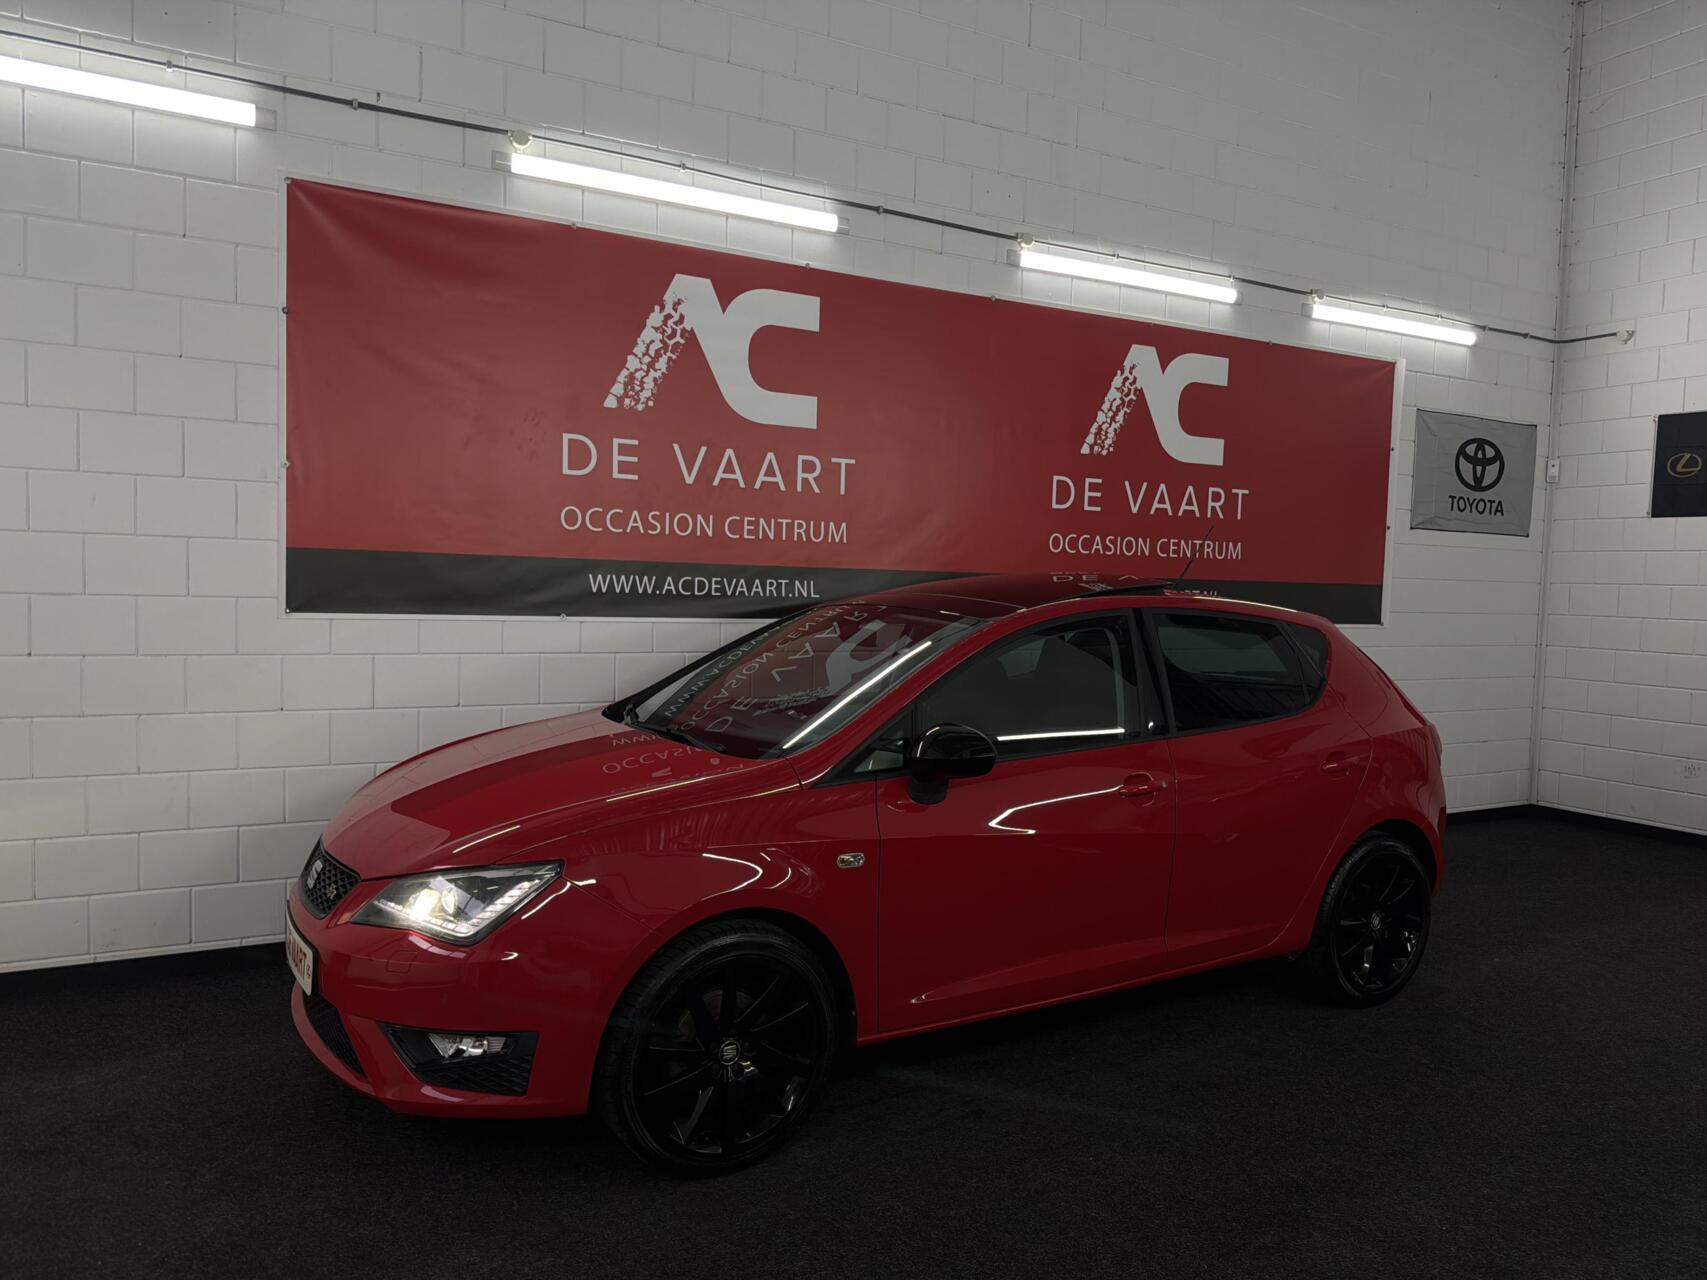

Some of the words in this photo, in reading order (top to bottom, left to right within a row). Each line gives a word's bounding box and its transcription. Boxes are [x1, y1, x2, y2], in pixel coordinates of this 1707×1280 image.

[603, 273, 821, 429] AC
[1080, 344, 1229, 466] AC
[562, 432, 639, 480] DE
[672, 443, 856, 495] VAART
[1051, 475, 1103, 511] DE
[1124, 480, 1250, 520] VAART
[1448, 495, 1505, 517] TOYOTA
[560, 506, 714, 537] OCCASION
[724, 516, 848, 544] CENTRUM
[1049, 533, 1150, 557] OCCASION
[1156, 538, 1242, 561] CENTRUM
[589, 573, 821, 598] WWW.ACDEVAART.NL
